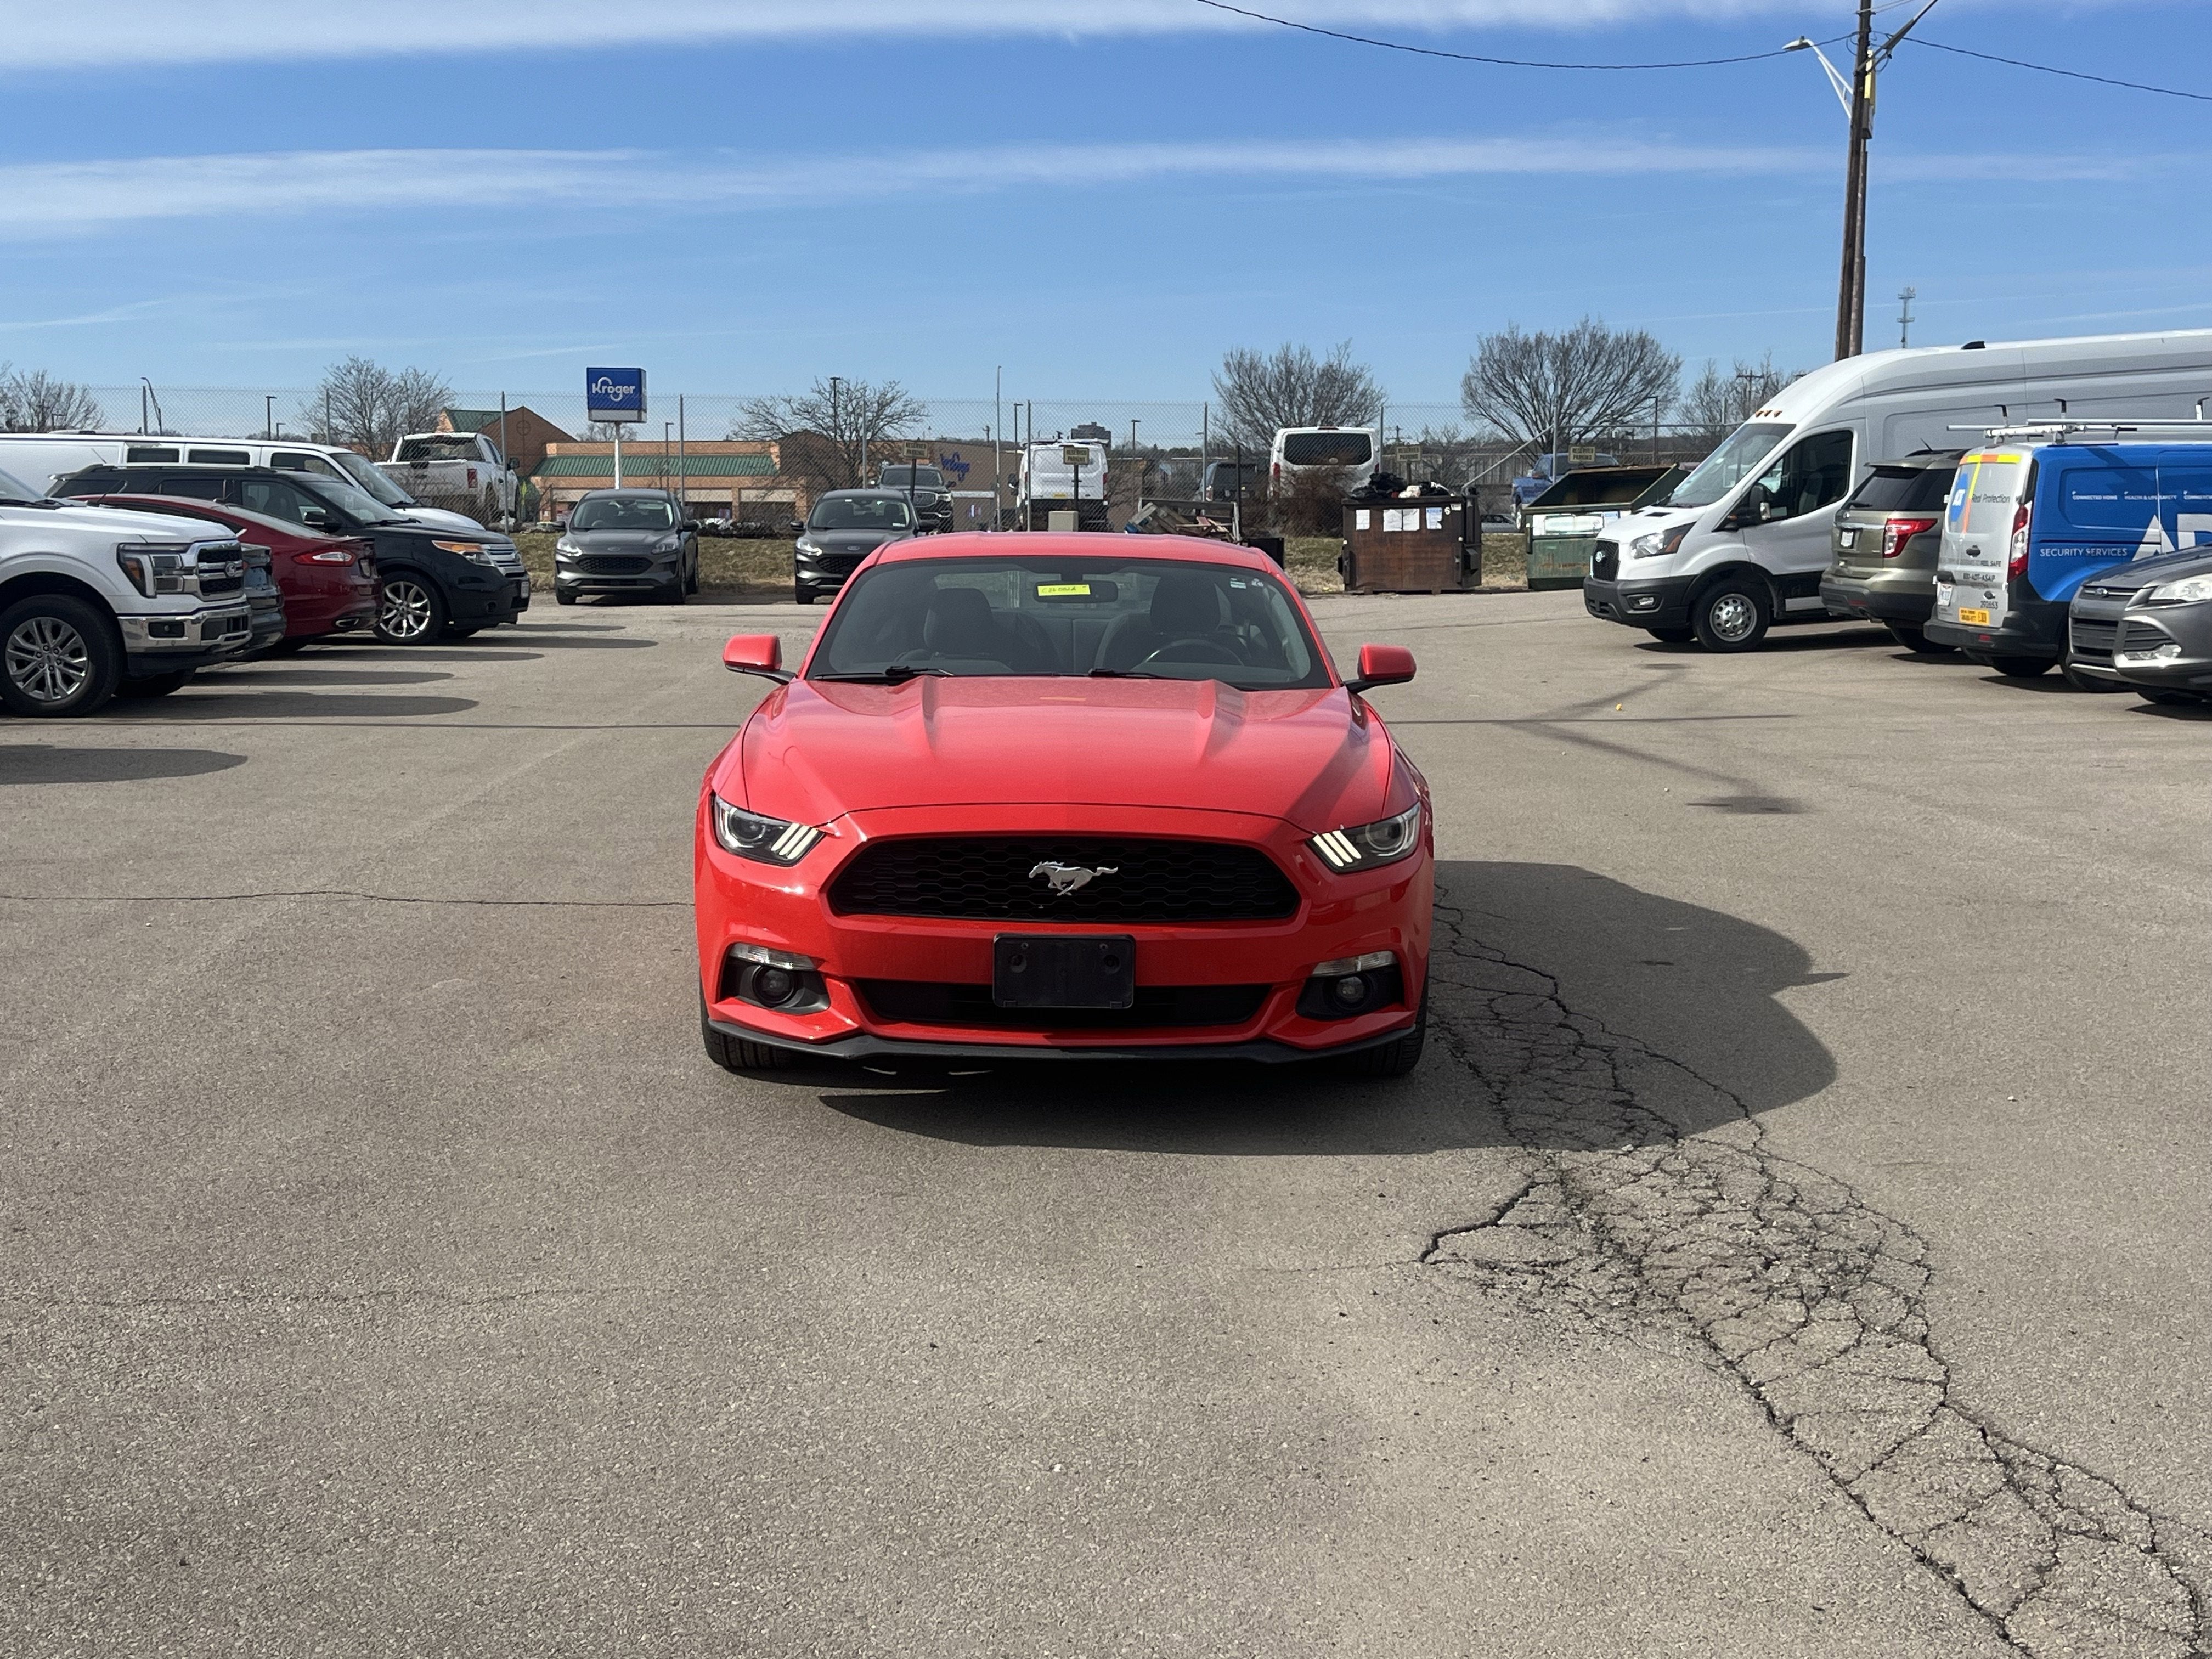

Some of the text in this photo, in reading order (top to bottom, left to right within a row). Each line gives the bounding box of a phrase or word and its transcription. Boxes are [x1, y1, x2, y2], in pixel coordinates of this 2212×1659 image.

[592, 377, 635, 402] Kroger
[1983, 493, 2011, 504] Protection
[1444, 507, 1451, 515] 6
[2040, 548, 2128, 557] SECURITY SERVICES
